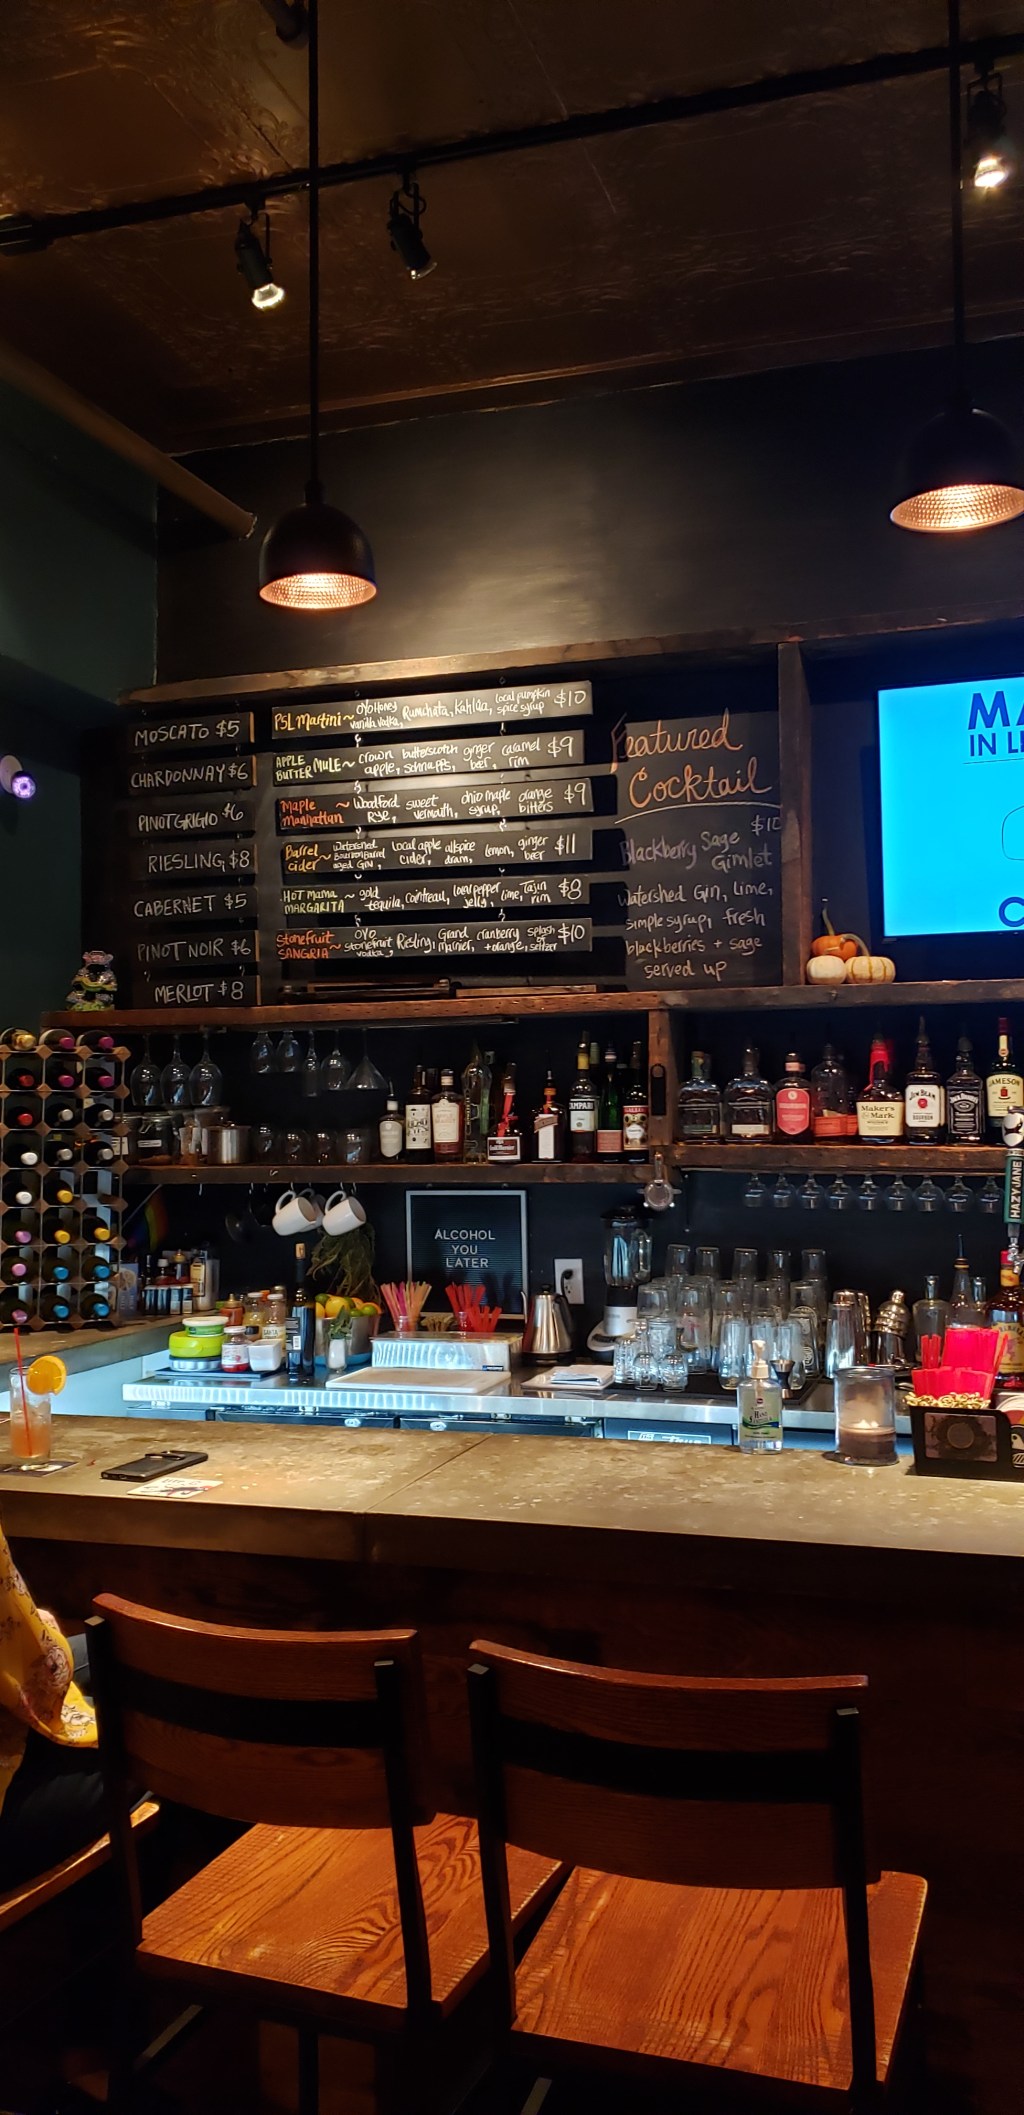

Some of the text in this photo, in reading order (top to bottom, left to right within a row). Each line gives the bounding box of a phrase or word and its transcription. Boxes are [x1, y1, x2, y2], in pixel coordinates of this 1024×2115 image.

[516, 687, 550, 704] pumpkin
[554, 689, 586, 708] $10
[497, 702, 544, 716] spice syrup
[275, 712, 342, 731] PSL Martini
[350, 718, 377, 730] vanilla
[135, 720, 240, 746] MOSCATO $5
[610, 707, 743, 774] Featured
[402, 743, 458, 760] butterscotch
[464, 742, 496, 761] ginger
[502, 737, 541, 756] caramel
[548, 736, 574, 758] $9
[970, 732, 996, 757] IN
[276, 755, 306, 768] APPLE
[313, 758, 342, 773] MULE
[364, 762, 400, 777] apple,
[509, 756, 530, 768] rim
[131, 763, 248, 788] CHARDONNAY $6
[276, 766, 313, 782] BUTTER
[629, 756, 772, 808] Cocktail
[354, 794, 439, 810] Woodford sweet
[518, 788, 554, 803] orange
[564, 782, 586, 806] $9
[280, 798, 316, 816] Maple
[469, 804, 500, 817] syrup,
[519, 802, 554, 814] bitters
[138, 802, 244, 832] PINOT GRIGIO $6
[333, 840, 378, 852] Watershed
[418, 836, 442, 855] apple
[444, 840, 476, 854] allspice
[518, 835, 549, 850] ginger
[554, 833, 576, 856] $11
[620, 832, 740, 870] Blackberry Sage
[286, 843, 319, 860] Barrel
[364, 848, 386, 859] Barrel
[524, 850, 546, 860] beer
[712, 842, 772, 872] Gimlet
[148, 850, 250, 872] RIESLING $8
[332, 860, 354, 872] aged
[283, 890, 305, 902] HOT
[359, 886, 380, 900] gold
[473, 882, 502, 896] pepper
[558, 878, 582, 900] $8
[618, 884, 686, 907] Watershed
[693, 884, 728, 904] Gin,
[134, 893, 248, 917] CABERNET $5
[532, 892, 551, 904] rim
[284, 900, 345, 914] MARGARITA
[626, 908, 766, 933] simple syrup, fresh
[276, 930, 335, 947] Stonefruit
[355, 928, 376, 940] OYO
[438, 926, 469, 940] Grand
[476, 927, 520, 942] cranberry
[527, 925, 556, 938] splash
[558, 923, 585, 944] $10
[138, 938, 252, 962] PINOT NOIR $6
[278, 948, 329, 960] SANGRIA
[530, 942, 558, 952] seltzer
[626, 935, 706, 958] blackberries
[730, 936, 763, 956] sage
[644, 960, 728, 982] served up
[155, 980, 244, 1004] MERLOT $8
[989, 1078, 1020, 1087] JAMESON
[1012, 1160, 1023, 1188] JANE
[1010, 1188, 1023, 1219] HAZY
[434, 1229, 496, 1240] ALCOHOL
[452, 1244, 478, 1254] YOU
[446, 1258, 488, 1268] LATER
